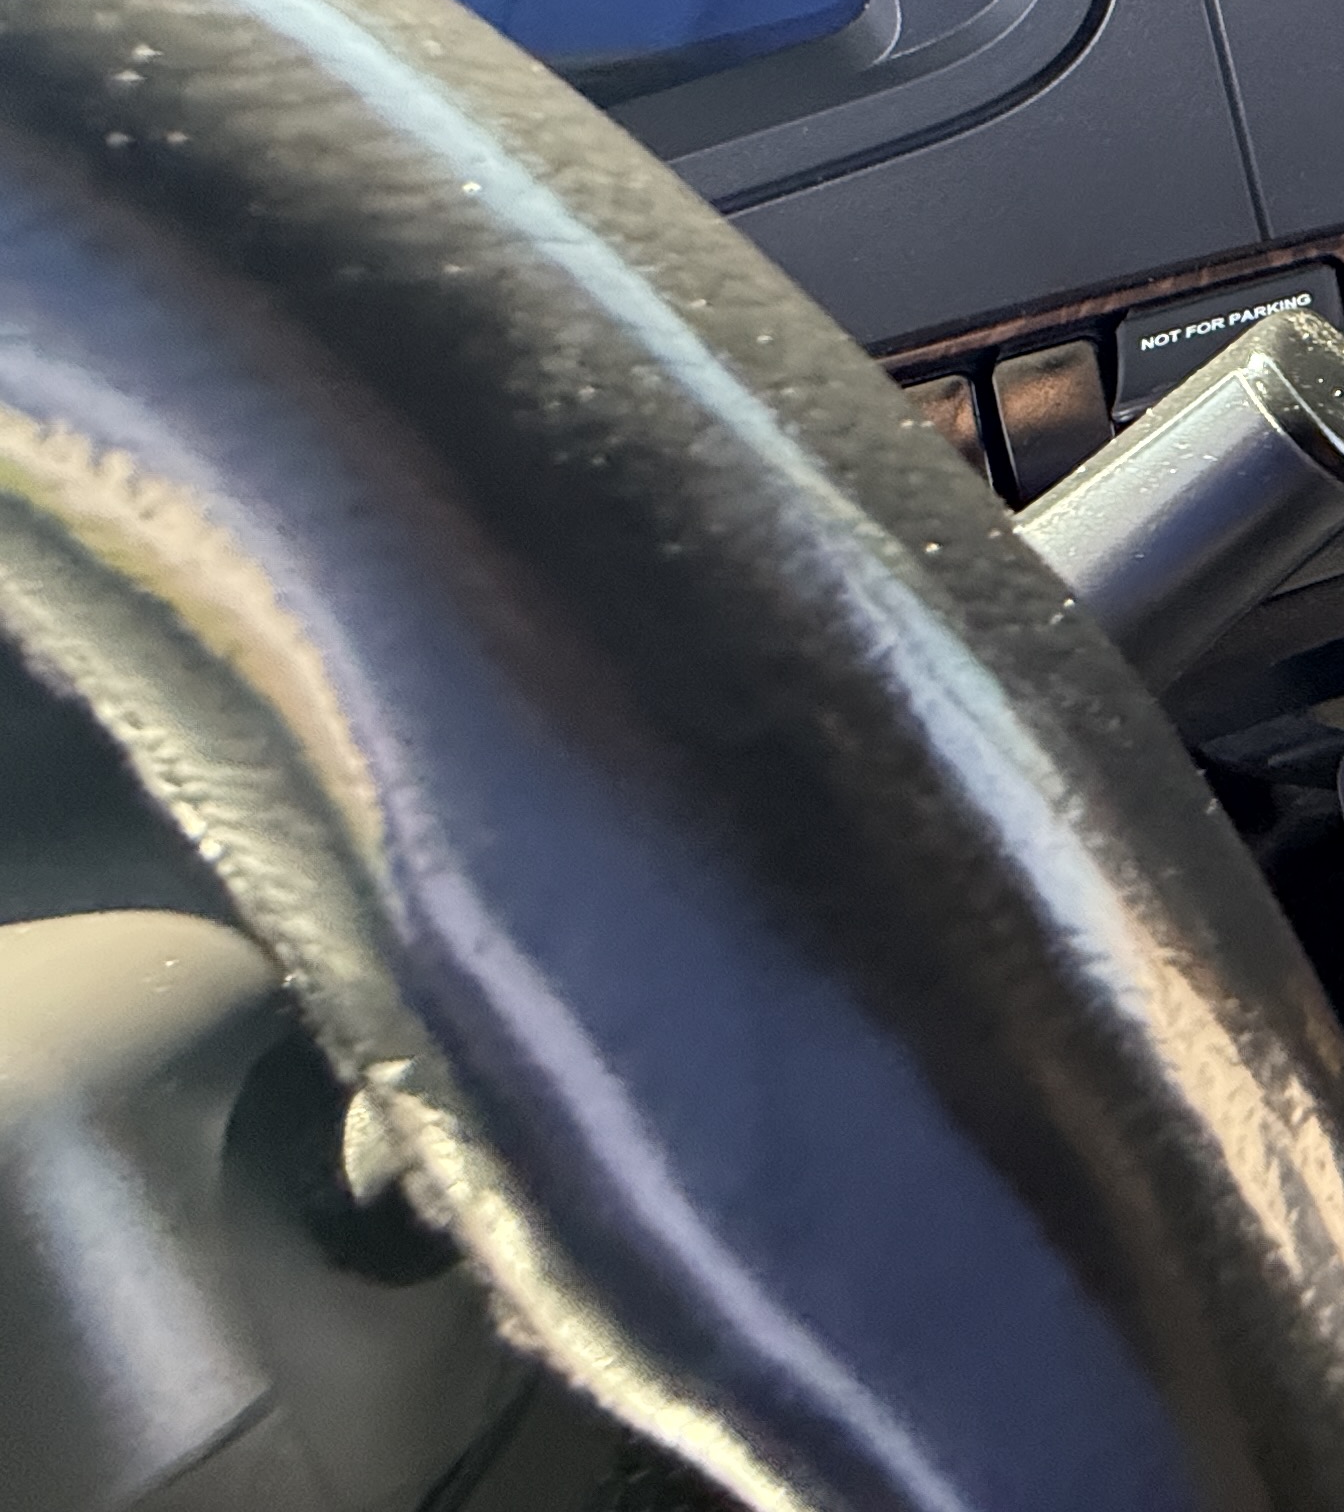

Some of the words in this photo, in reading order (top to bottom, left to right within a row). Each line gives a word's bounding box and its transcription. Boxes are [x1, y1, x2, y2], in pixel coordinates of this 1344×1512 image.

[1139, 328, 1183, 352] NOT
[1185, 316, 1226, 339] FOR
[1227, 292, 1313, 327] PARKING
